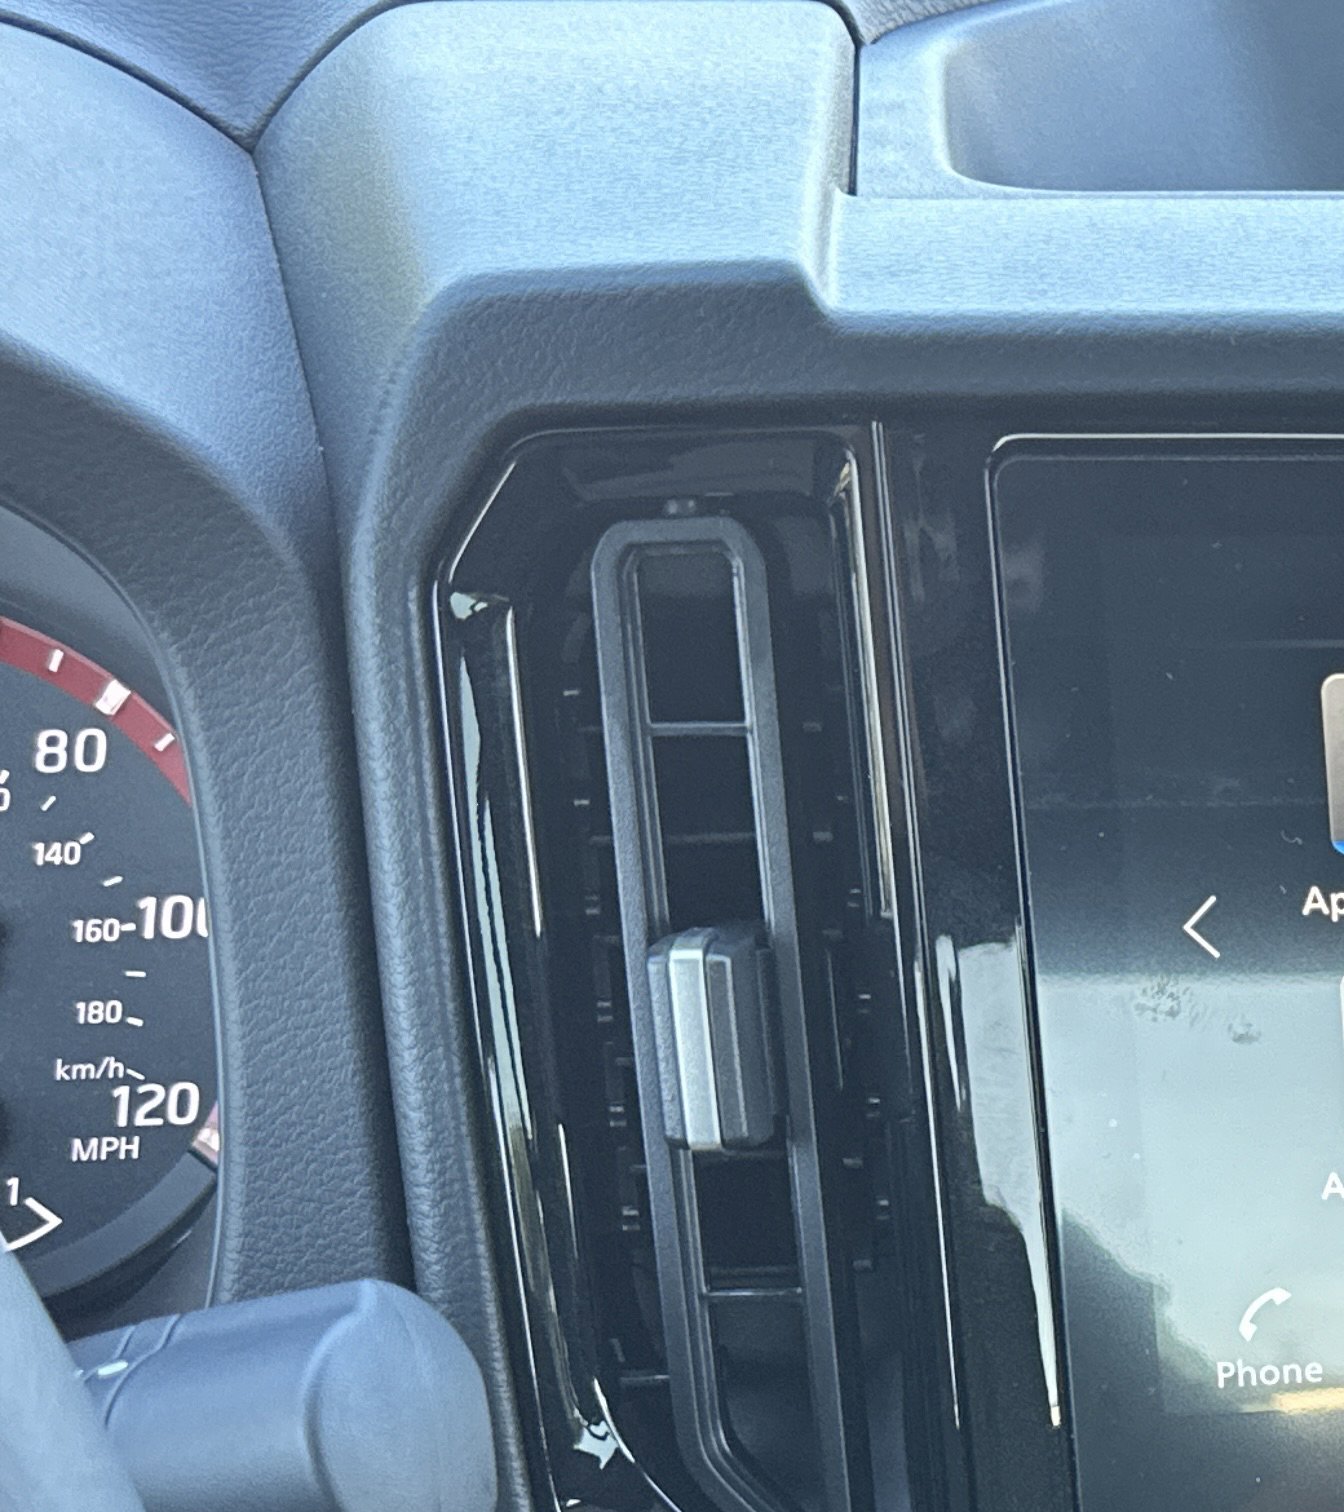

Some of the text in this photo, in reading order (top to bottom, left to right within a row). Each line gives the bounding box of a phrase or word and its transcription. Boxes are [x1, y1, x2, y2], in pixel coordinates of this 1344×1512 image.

[35, 728, 107, 773] 80
[34, 841, 81, 866] 140
[73, 918, 120, 942] 160
[76, 1000, 123, 1024] 180
[55, 1057, 124, 1081] km/h
[113, 1082, 200, 1127] 120
[71, 1135, 140, 1162] MPH
[1216, 1358, 1323, 1388] Phone
